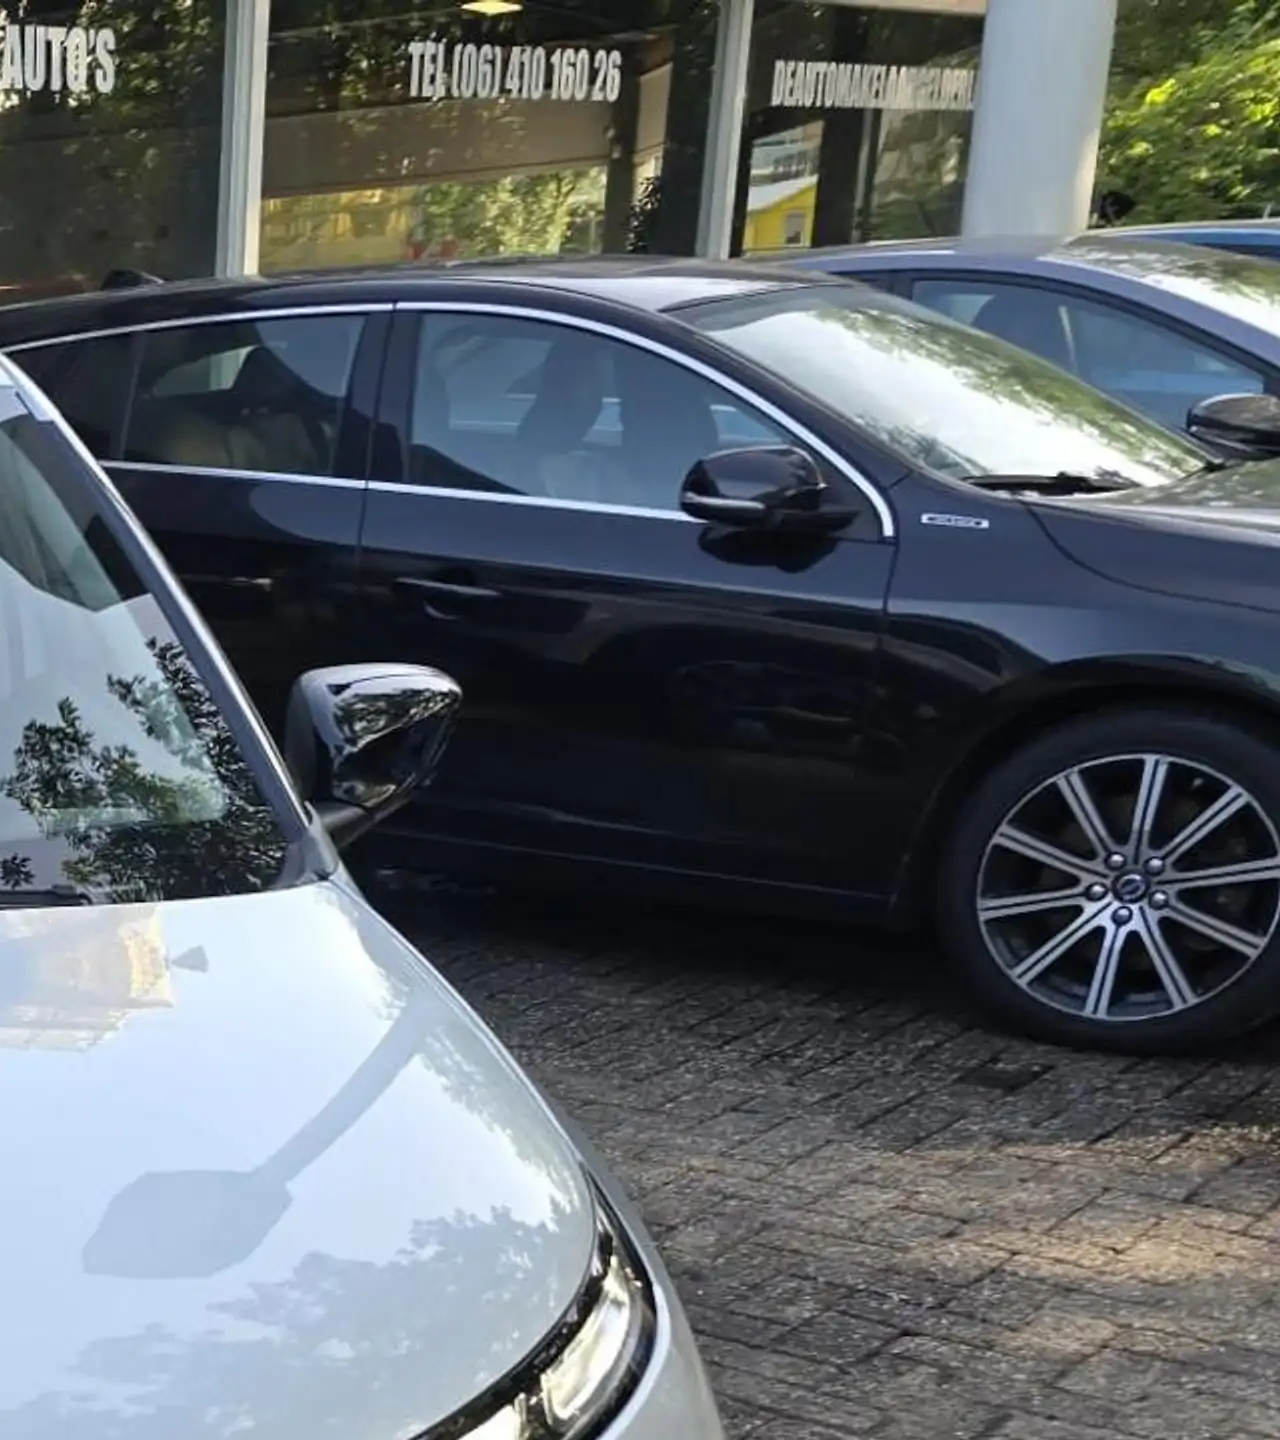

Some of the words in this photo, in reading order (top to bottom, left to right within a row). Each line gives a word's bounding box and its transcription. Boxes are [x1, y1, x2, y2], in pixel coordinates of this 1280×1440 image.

[2, 23, 116, 93] AUTO'S
[452, 43, 502, 98] (06)
[505, 45, 545, 99] 410
[550, 48, 589, 100] 160
[591, 49, 622, 102] 26
